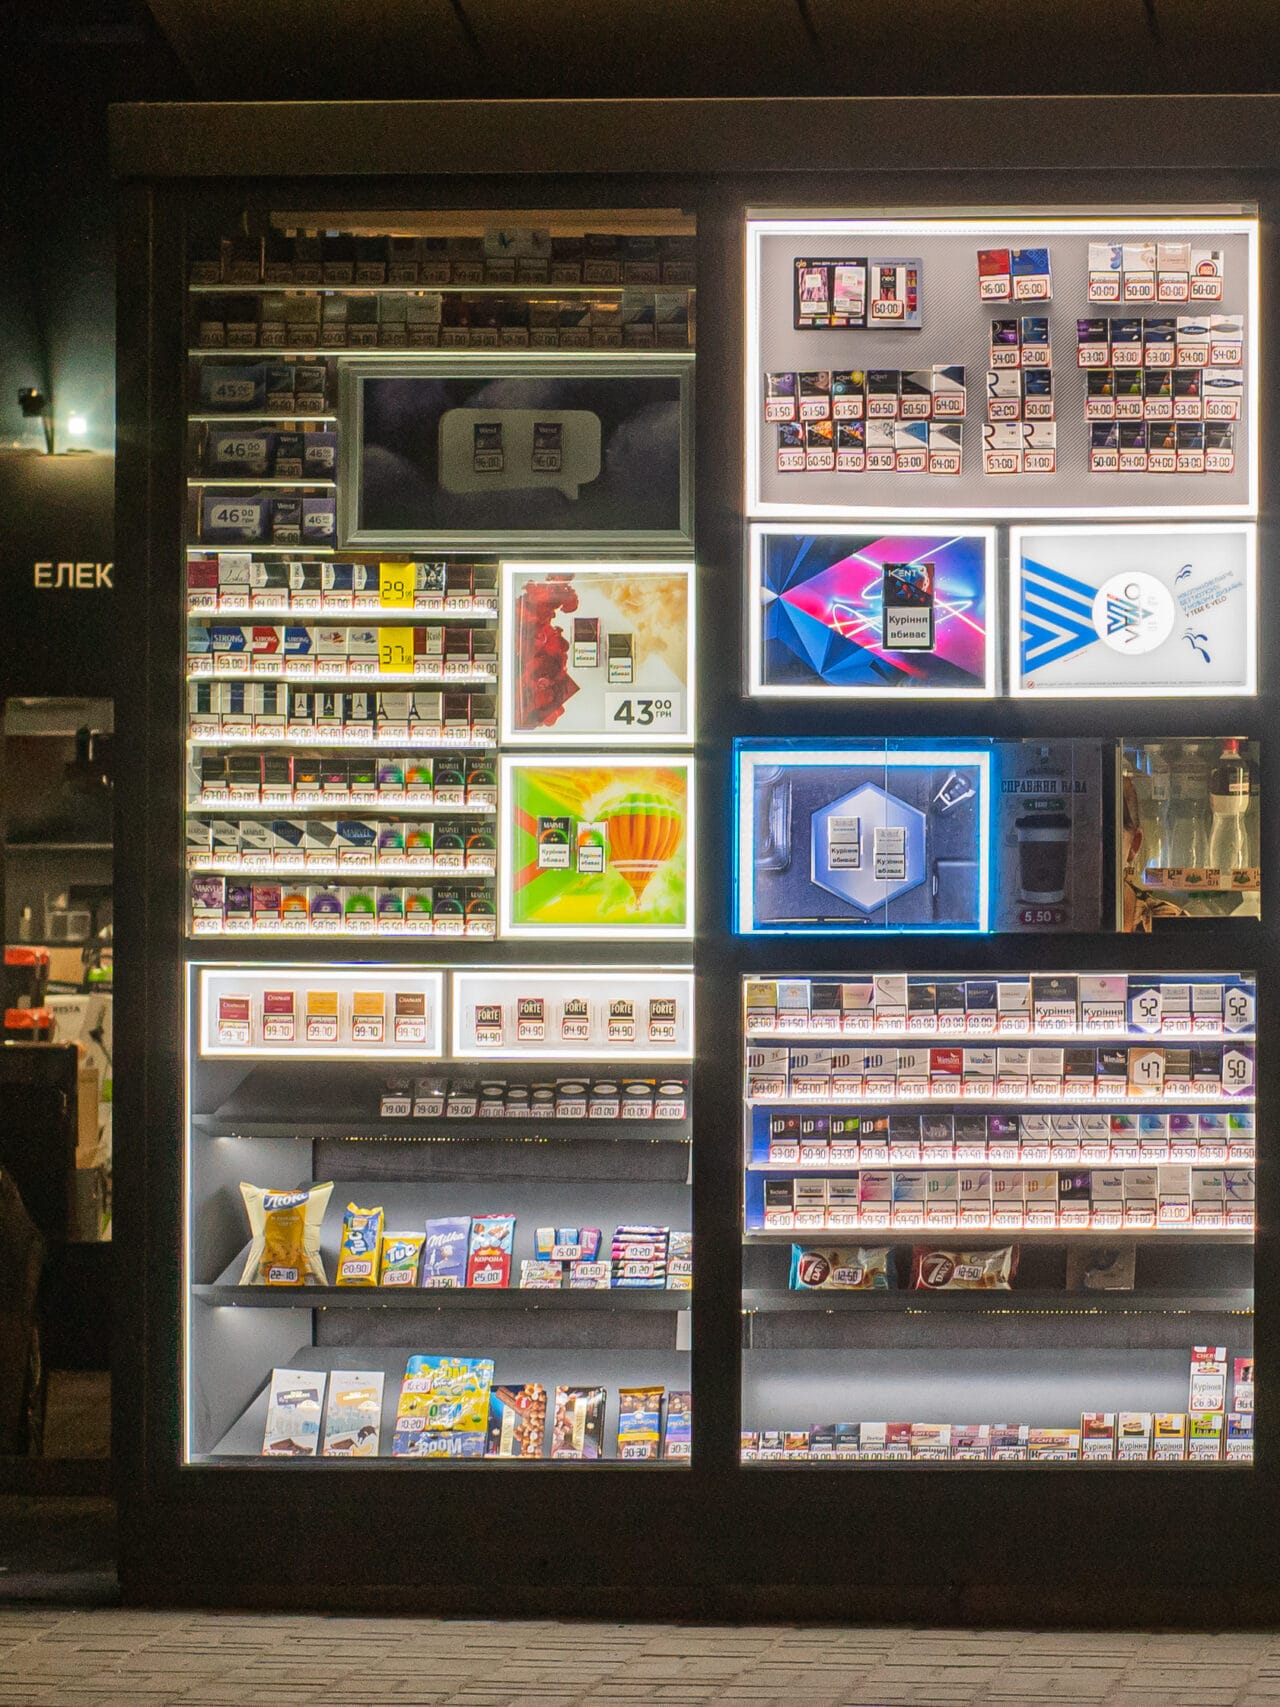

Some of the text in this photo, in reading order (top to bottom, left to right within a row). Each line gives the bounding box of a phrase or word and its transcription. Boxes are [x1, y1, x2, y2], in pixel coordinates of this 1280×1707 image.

[224, 443, 246, 457] 46
[309, 450, 323, 458] 46
[217, 509, 240, 523] 46
[308, 516, 322, 524] 46
[34, 562, 114, 588] ЕЛЕК
[888, 568, 918, 578] KENT
[382, 581, 405, 600] 29
[888, 615, 929, 628] Куріння
[382, 645, 405, 664] 37
[613, 700, 672, 726] 43 00
[655, 710, 672, 719] ГРН
[1001, 780, 1056, 793] СПРАВЖНЯ
[520, 1003, 541, 1014] FORTE
[564, 1003, 588, 1013] FORTE
[611, 1004, 632, 1014] FORTE
[651, 1003, 674, 1015] FORTE
[1035, 1007, 1075, 1017] Куріння
[1084, 1007, 1123, 1018] Куріння
[1139, 998, 1158, 1017] 52
[1228, 998, 1247, 1016] 52
[477, 1010, 500, 1021] FORTE
[1141, 1061, 1160, 1079] 47
[1227, 1059, 1246, 1079] 50
[427, 1232, 465, 1248] Milka
[386, 1243, 418, 1263] TUC
[802, 1255, 821, 1282] 7
[926, 1256, 945, 1284] 7
[1194, 1382, 1222, 1391] Куріння
[1084, 1442, 1111, 1451] Куріння
[1155, 1442, 1183, 1451] Куріння
